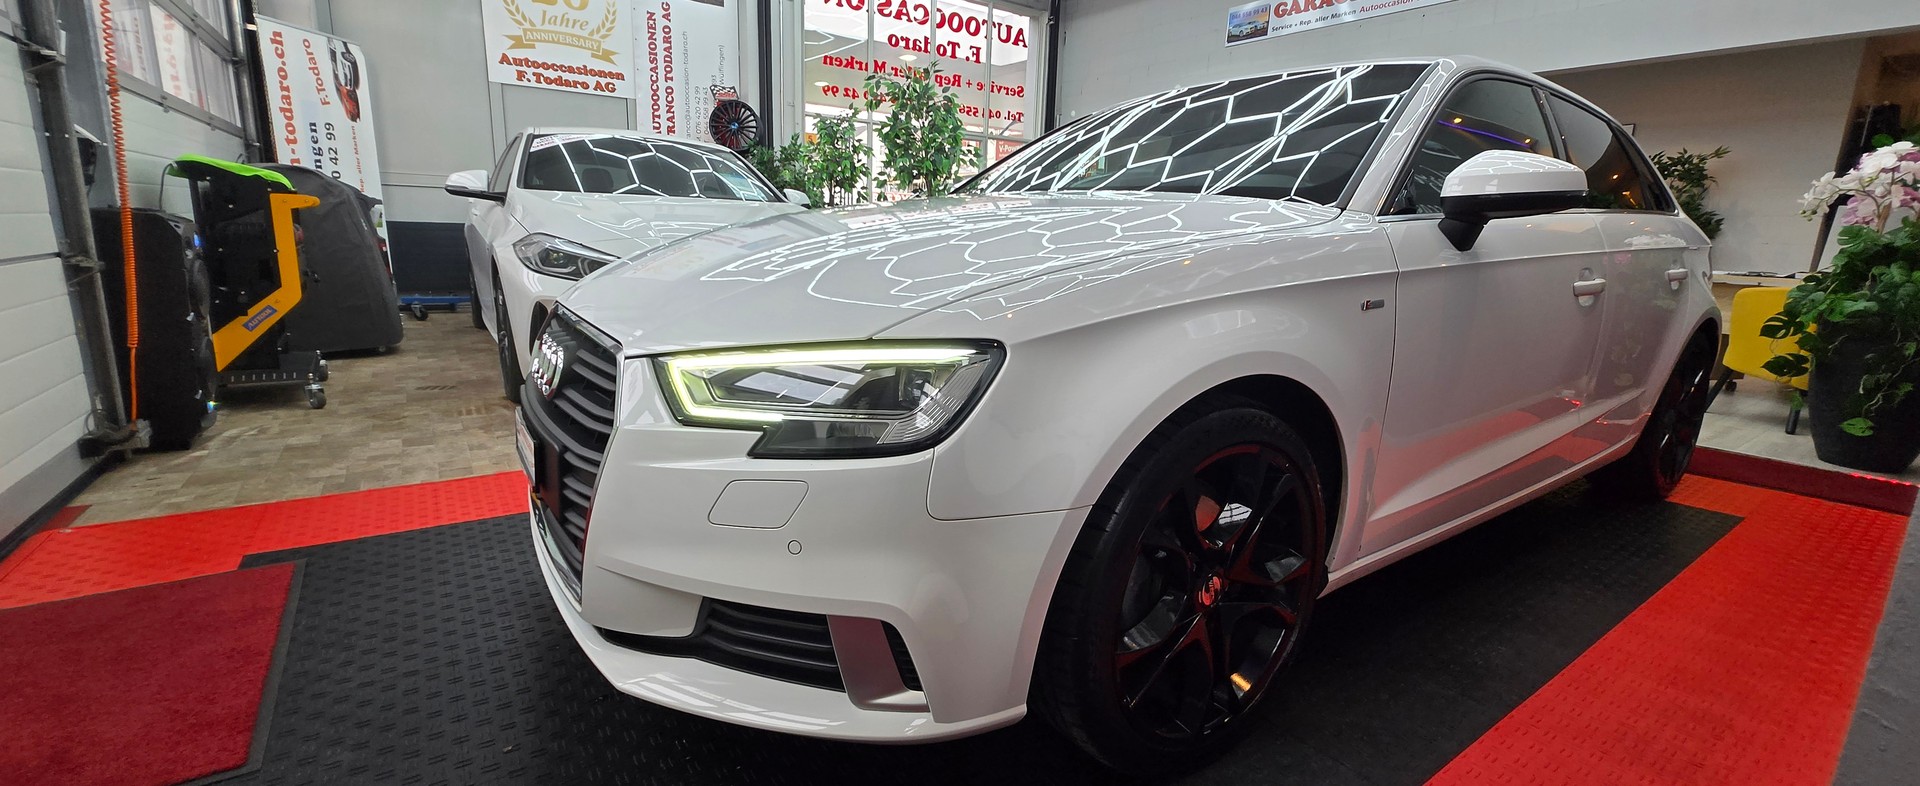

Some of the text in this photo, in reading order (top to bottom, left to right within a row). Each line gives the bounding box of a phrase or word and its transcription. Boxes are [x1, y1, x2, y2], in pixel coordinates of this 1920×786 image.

[541, 10, 589, 31] Jahre
[661, 2, 671, 23] AG
[1271, 24, 1293, 33] Service
[1299, 19, 1313, 27] Rep.
[1315, 15, 1329, 23] aller
[1331, 9, 1357, 20] Marken
[526, 31, 599, 50] ANNIVERSARY
[662, 25, 673, 83] TODARO
[498, 52, 625, 81] Autooccasionen
[516, 70, 617, 93] F. Todaro AG
[324, 122, 336, 142] 99
[328, 148, 339, 167] 42
